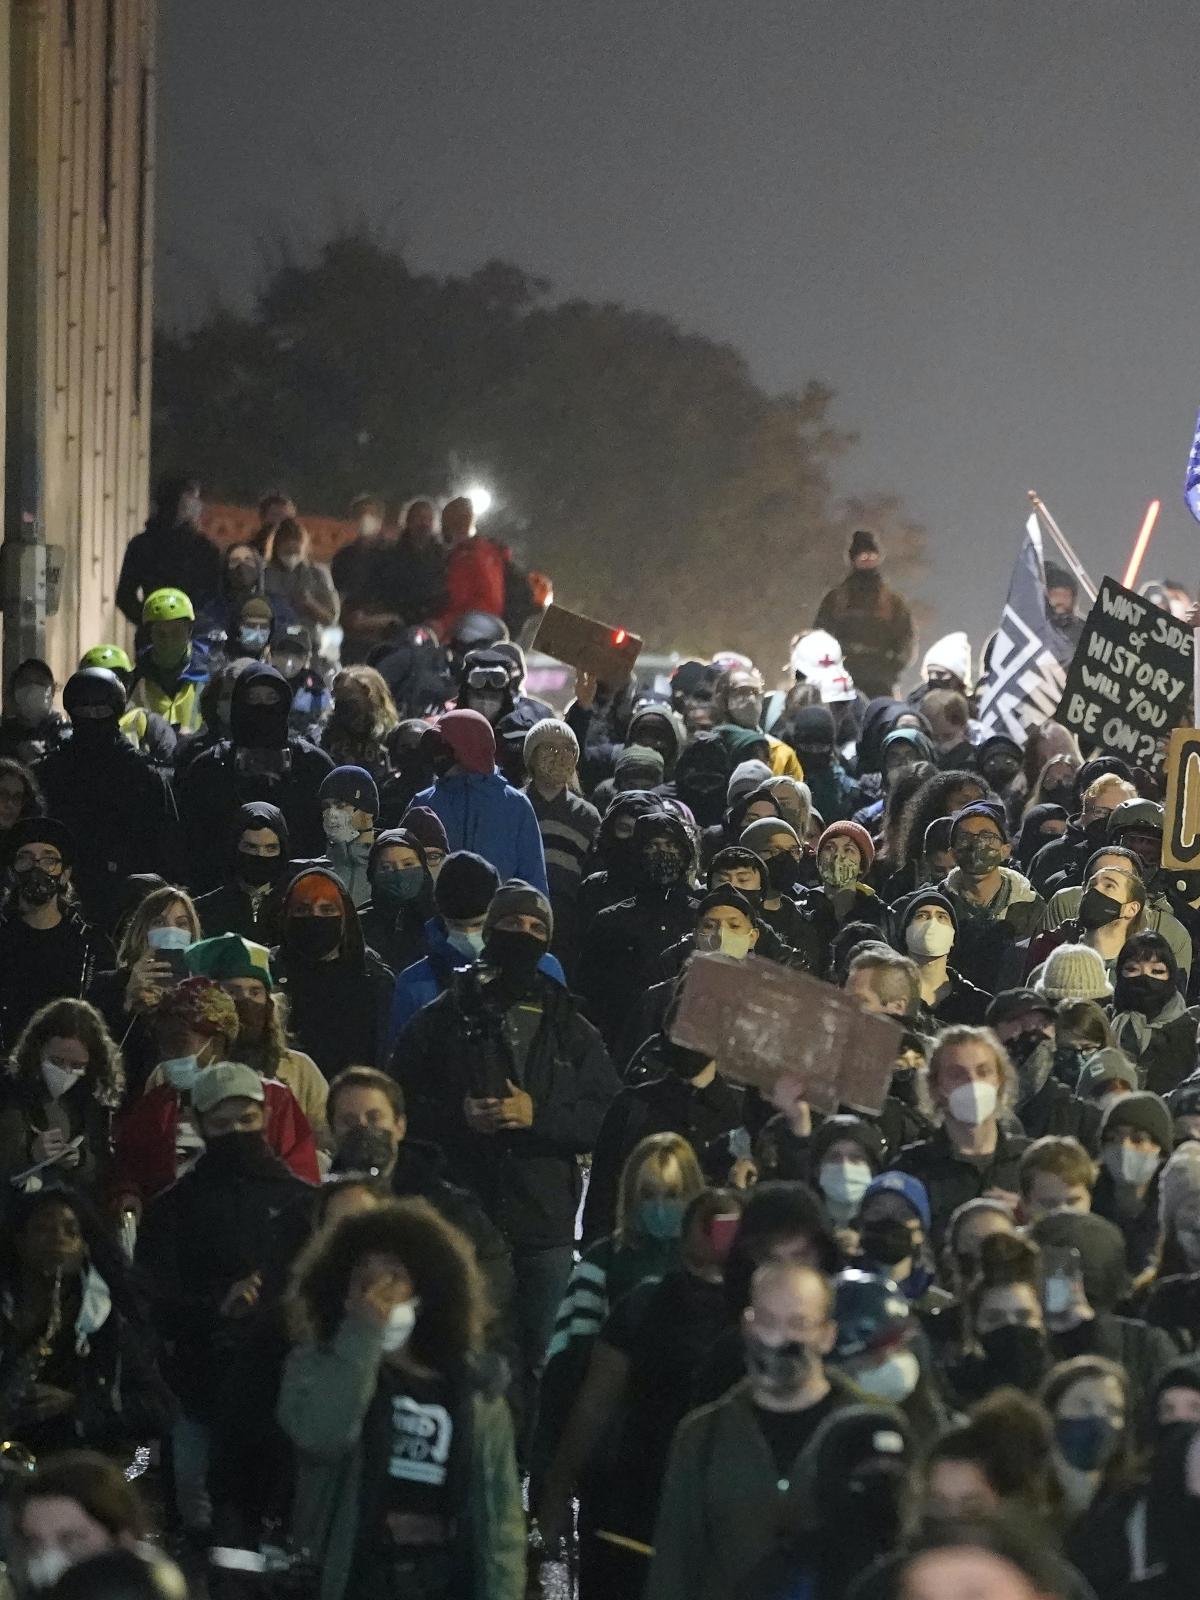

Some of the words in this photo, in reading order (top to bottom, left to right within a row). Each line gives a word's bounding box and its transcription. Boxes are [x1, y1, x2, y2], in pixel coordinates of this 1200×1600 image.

[1102, 586, 1147, 627] WHAT
[1151, 617, 1194, 656] SIDE
[1082, 665, 1121, 704] WILL
[1125, 688, 1168, 728] YOU
[1087, 631, 1186, 703] HISTORY
[1067, 693, 1102, 734] BE
